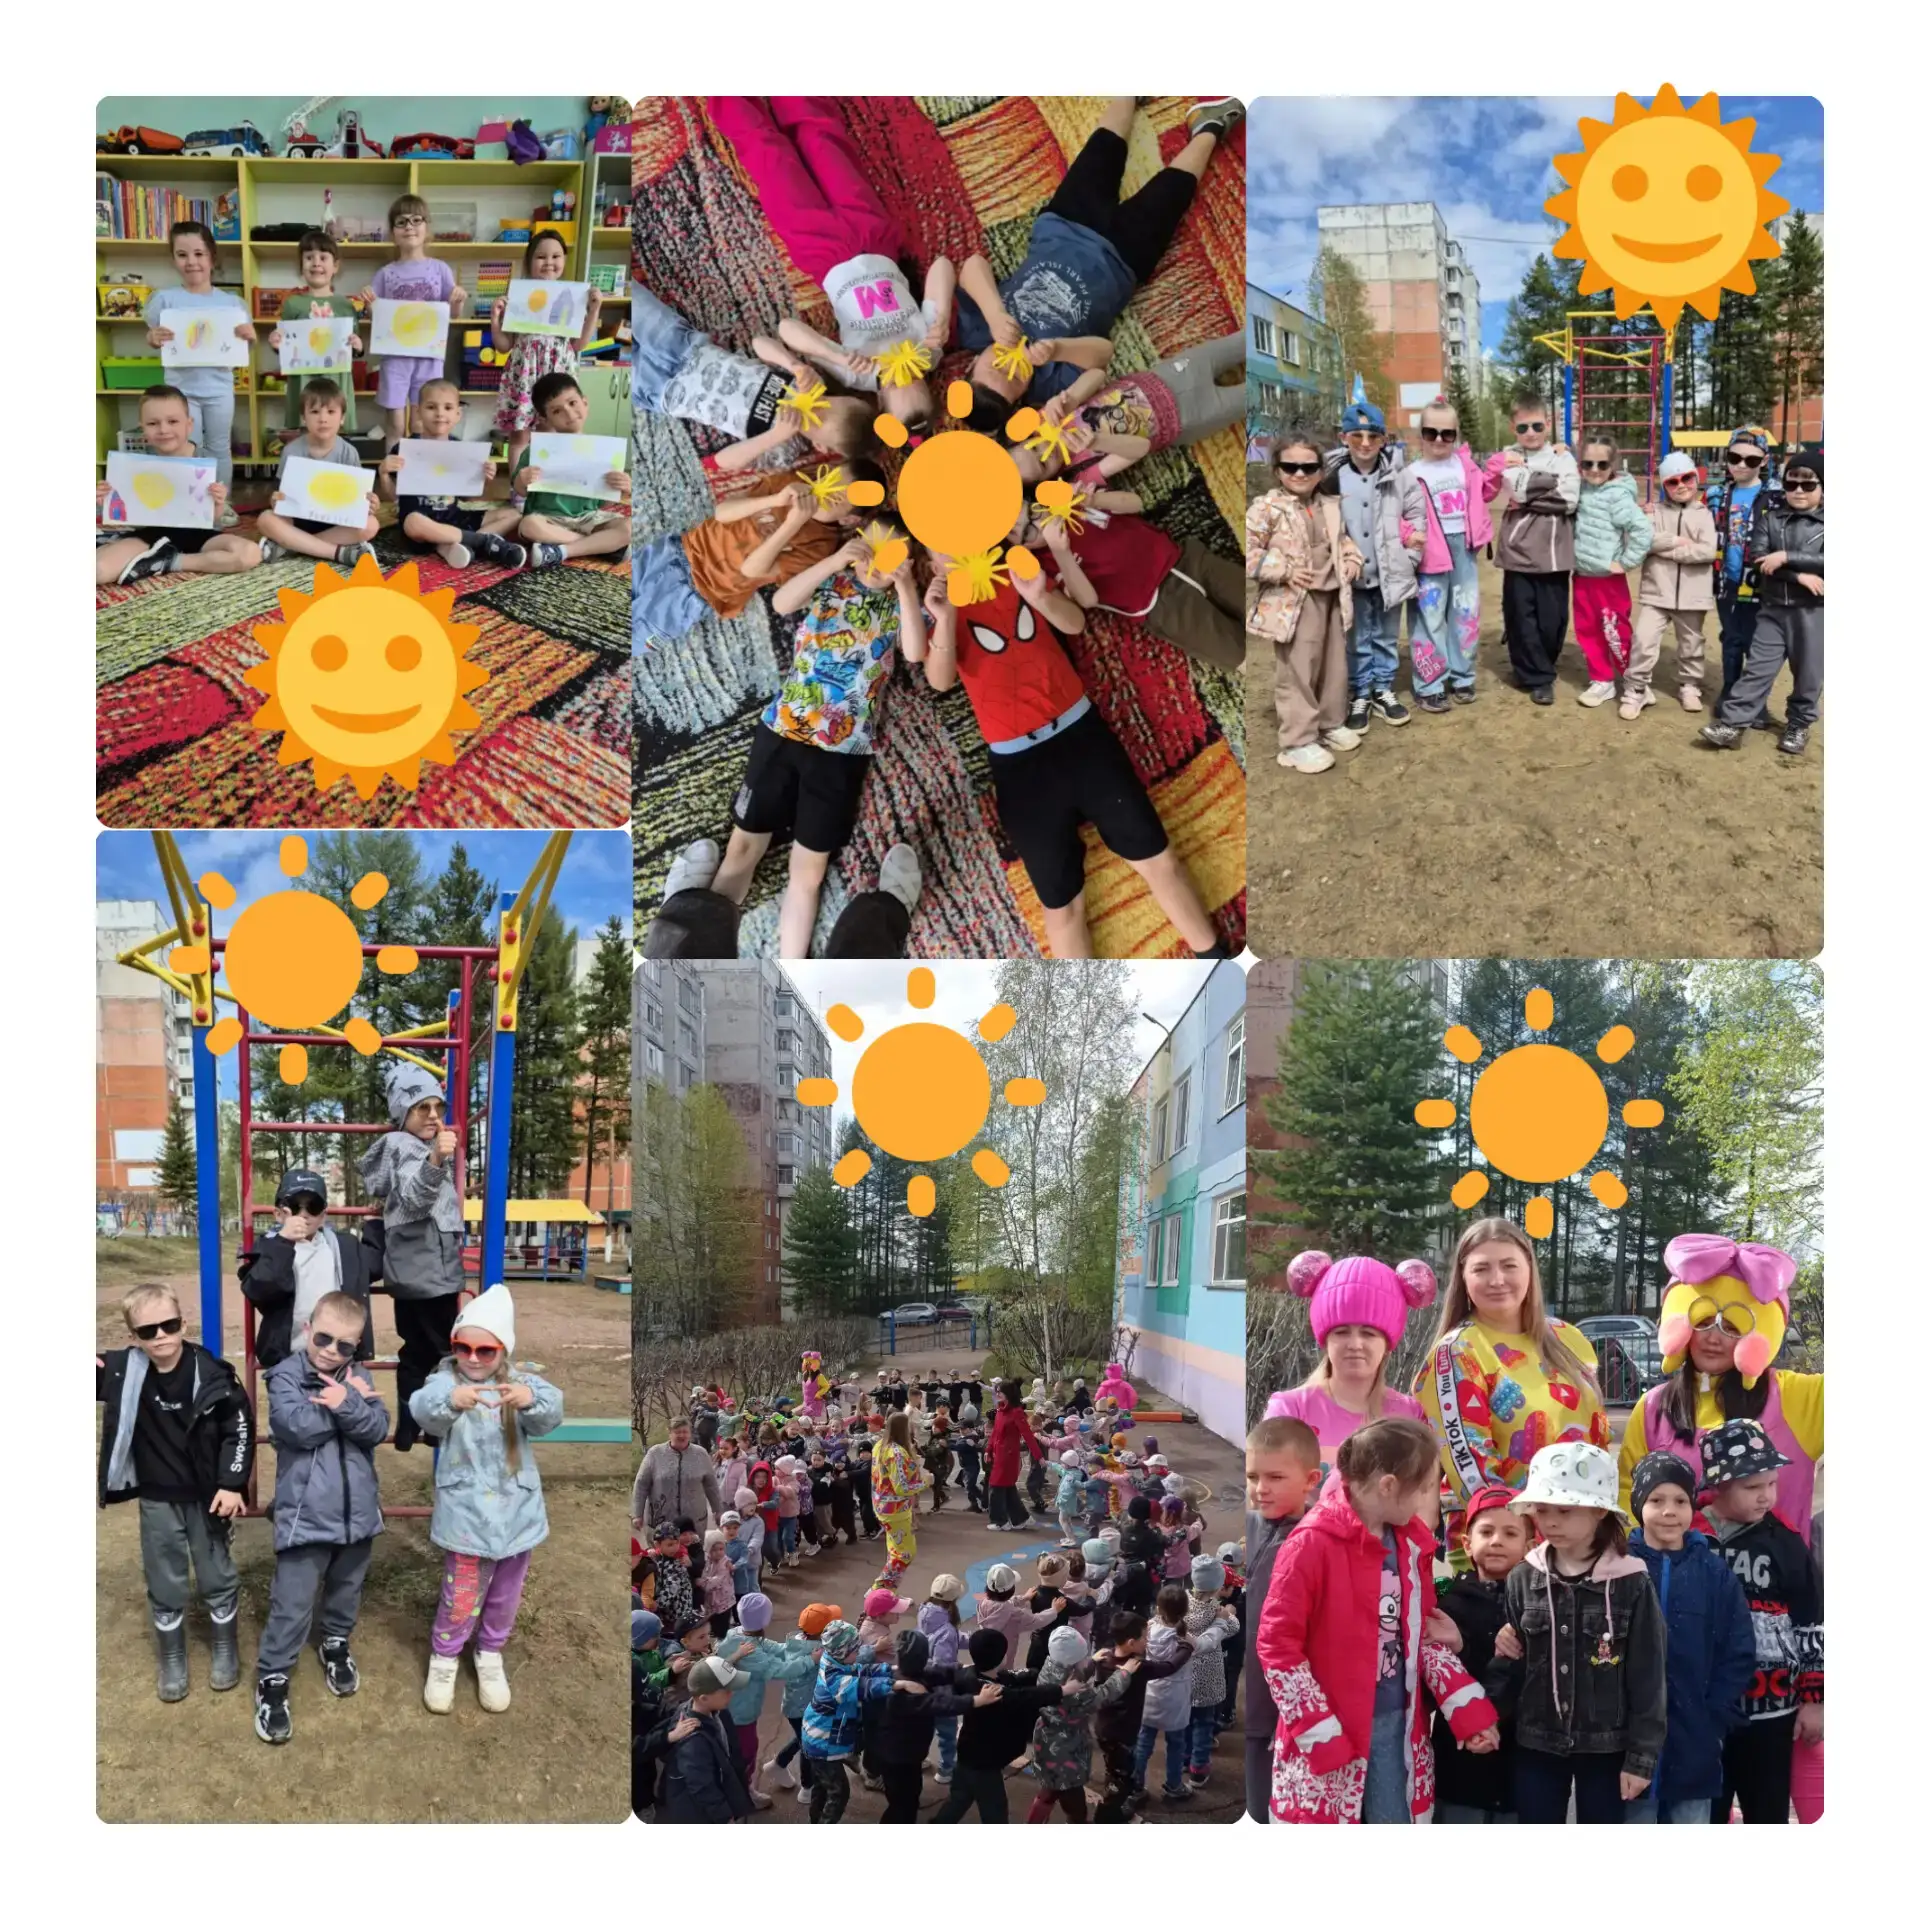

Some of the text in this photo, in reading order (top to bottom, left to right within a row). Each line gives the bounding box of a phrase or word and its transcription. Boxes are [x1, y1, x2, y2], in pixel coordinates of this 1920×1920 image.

[853, 279, 901, 320] M
[753, 397, 775, 423] FAST
[1438, 1344, 1452, 1397] YouTube
[230, 1423, 248, 1473] Swoosh
